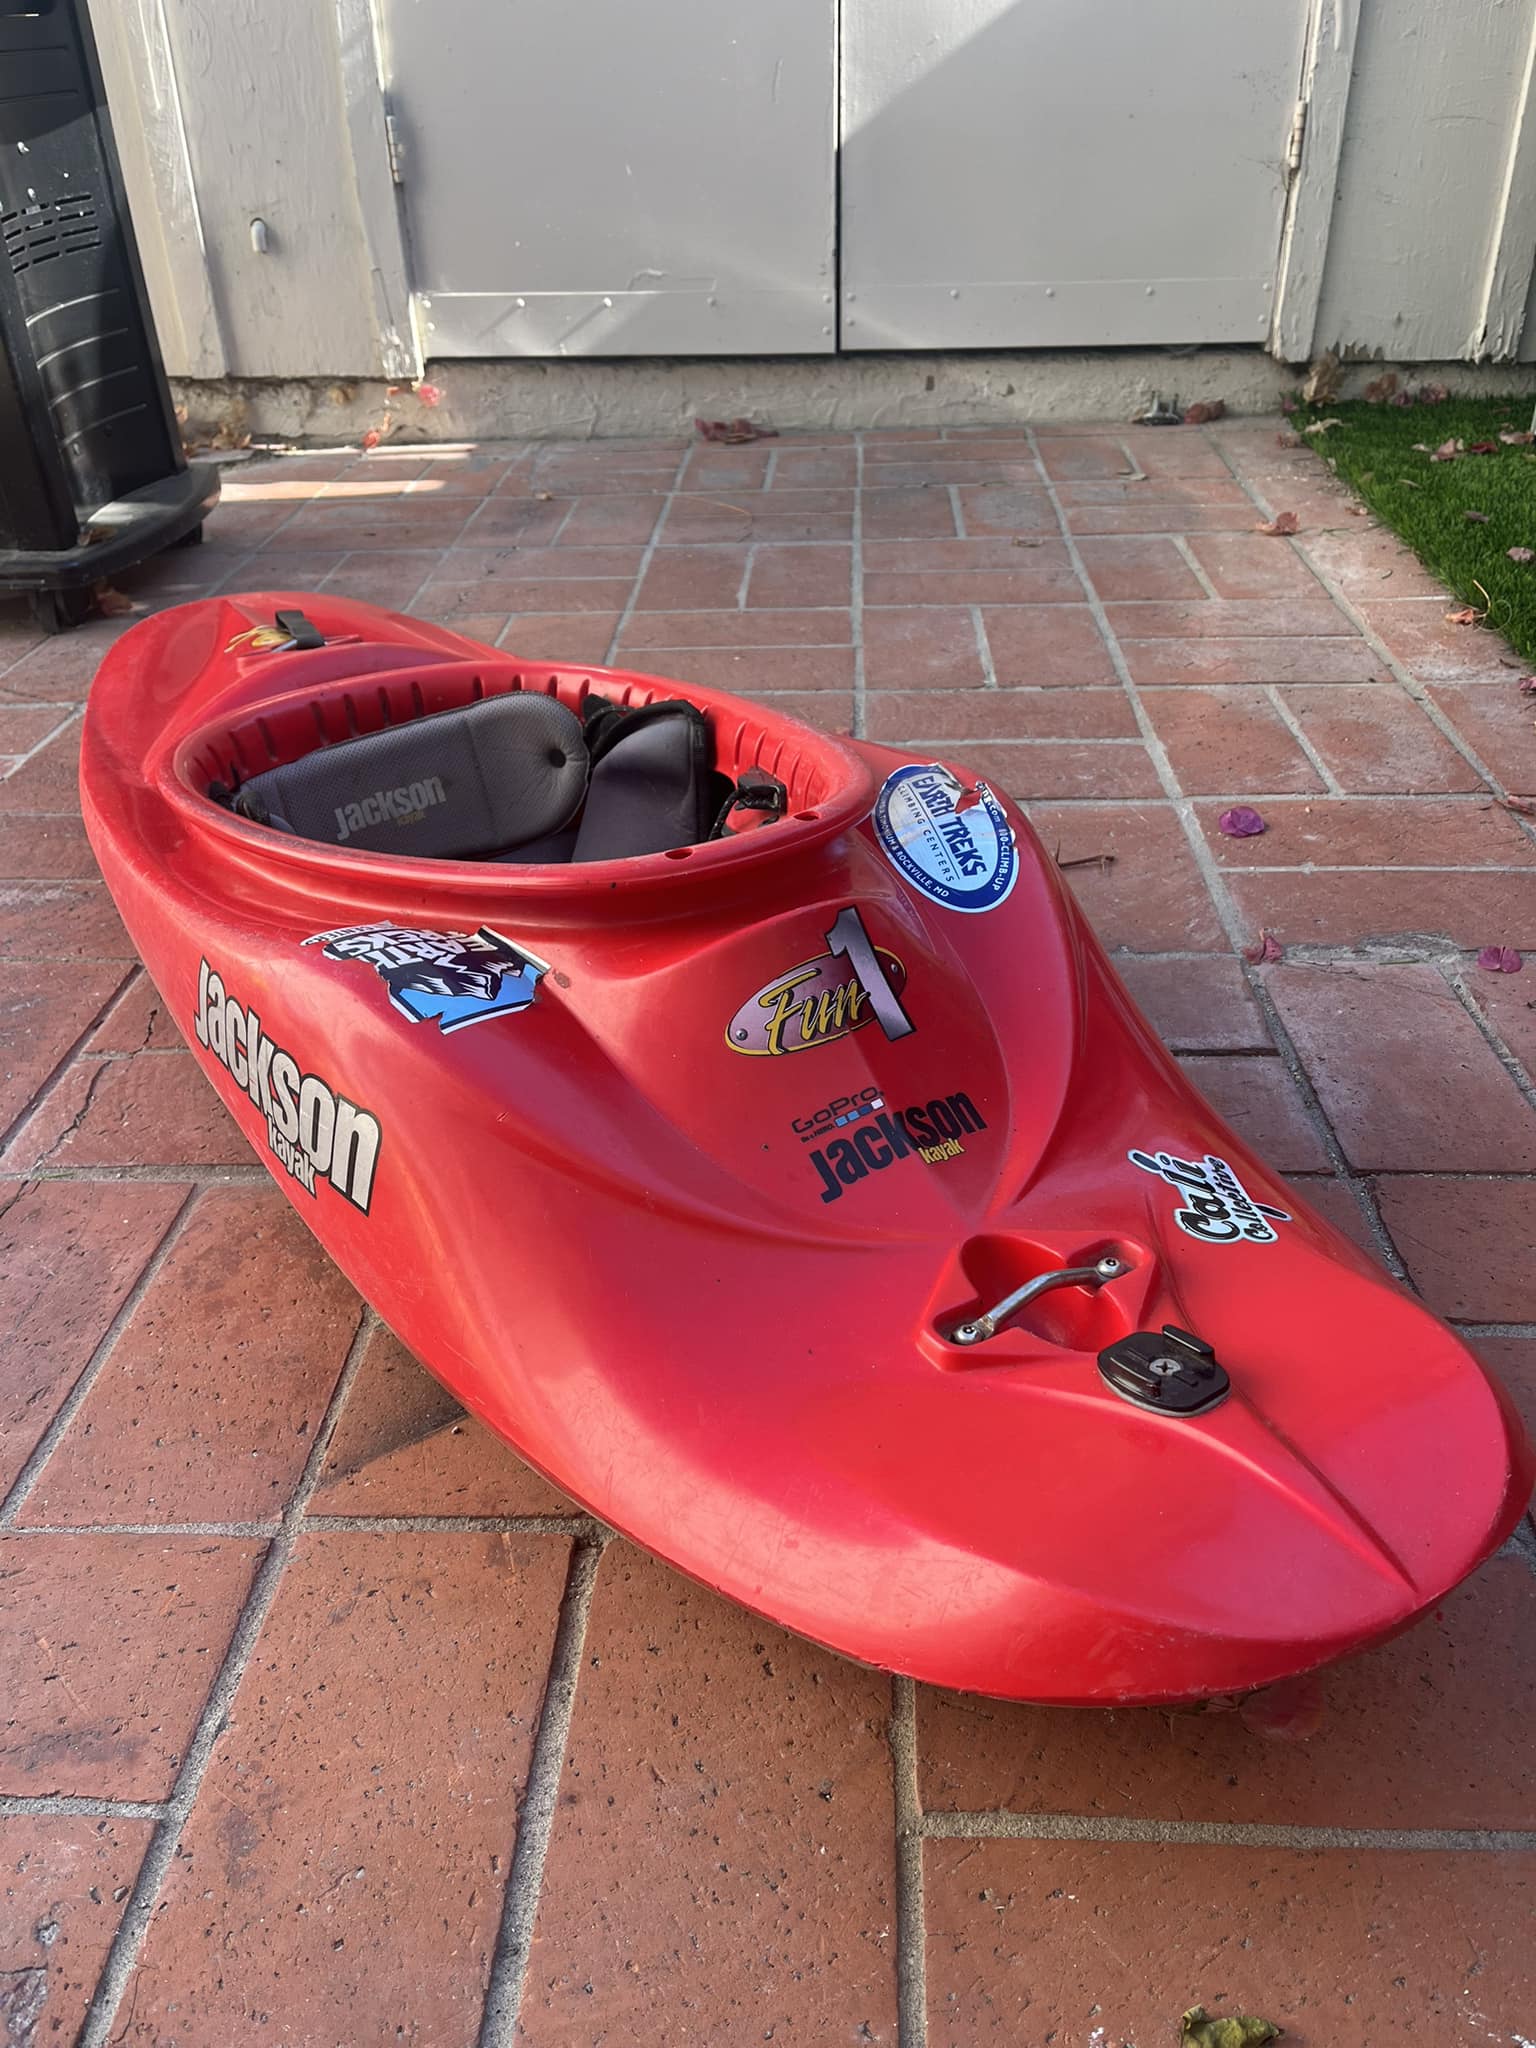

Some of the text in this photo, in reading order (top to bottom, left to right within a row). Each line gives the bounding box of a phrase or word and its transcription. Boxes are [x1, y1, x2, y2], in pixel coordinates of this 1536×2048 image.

[333, 775, 448, 841] Jackson
[897, 785, 955, 883] CLIMBING CENTERS
[912, 776, 988, 877] EARTH TREKS
[933, 884, 950, 897] MD
[758, 904, 917, 1056] Fun 1
[193, 955, 383, 1218] Jackson
[809, 1092, 988, 1204] Jackson
[917, 1137, 967, 1165] kayak
[1158, 1153, 1241, 1240] Cali
